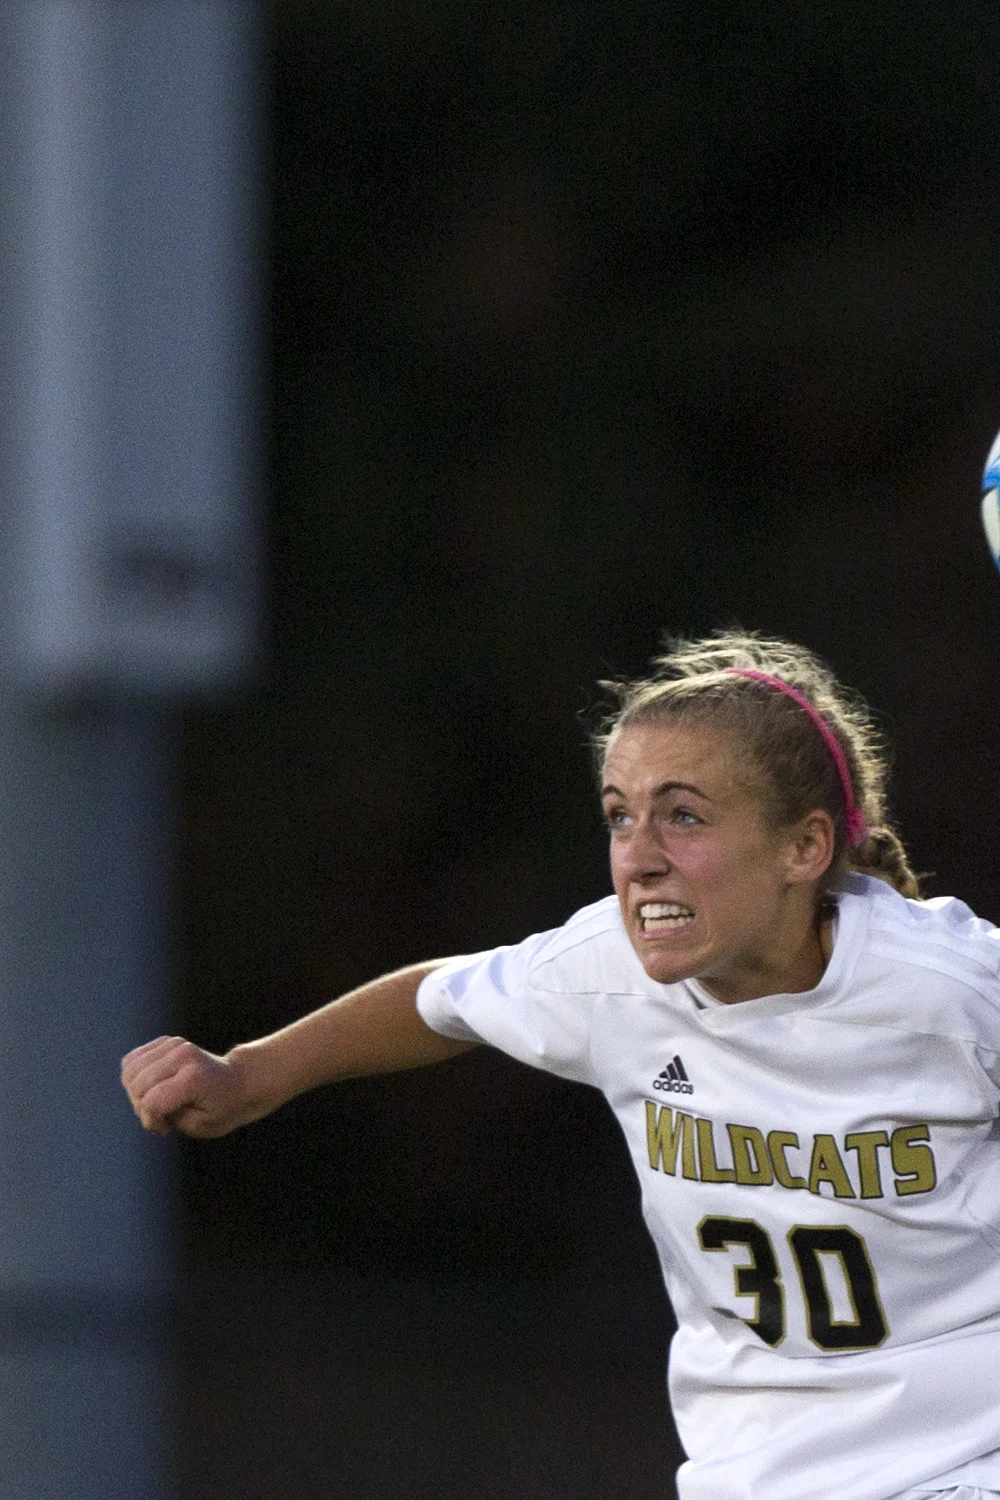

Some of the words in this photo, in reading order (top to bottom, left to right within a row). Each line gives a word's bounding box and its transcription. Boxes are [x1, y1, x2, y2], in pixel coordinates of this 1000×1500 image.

[652, 1079, 694, 1095] adidas
[645, 1100, 937, 1200] WILDCATS
[696, 1214, 891, 1351] 30
